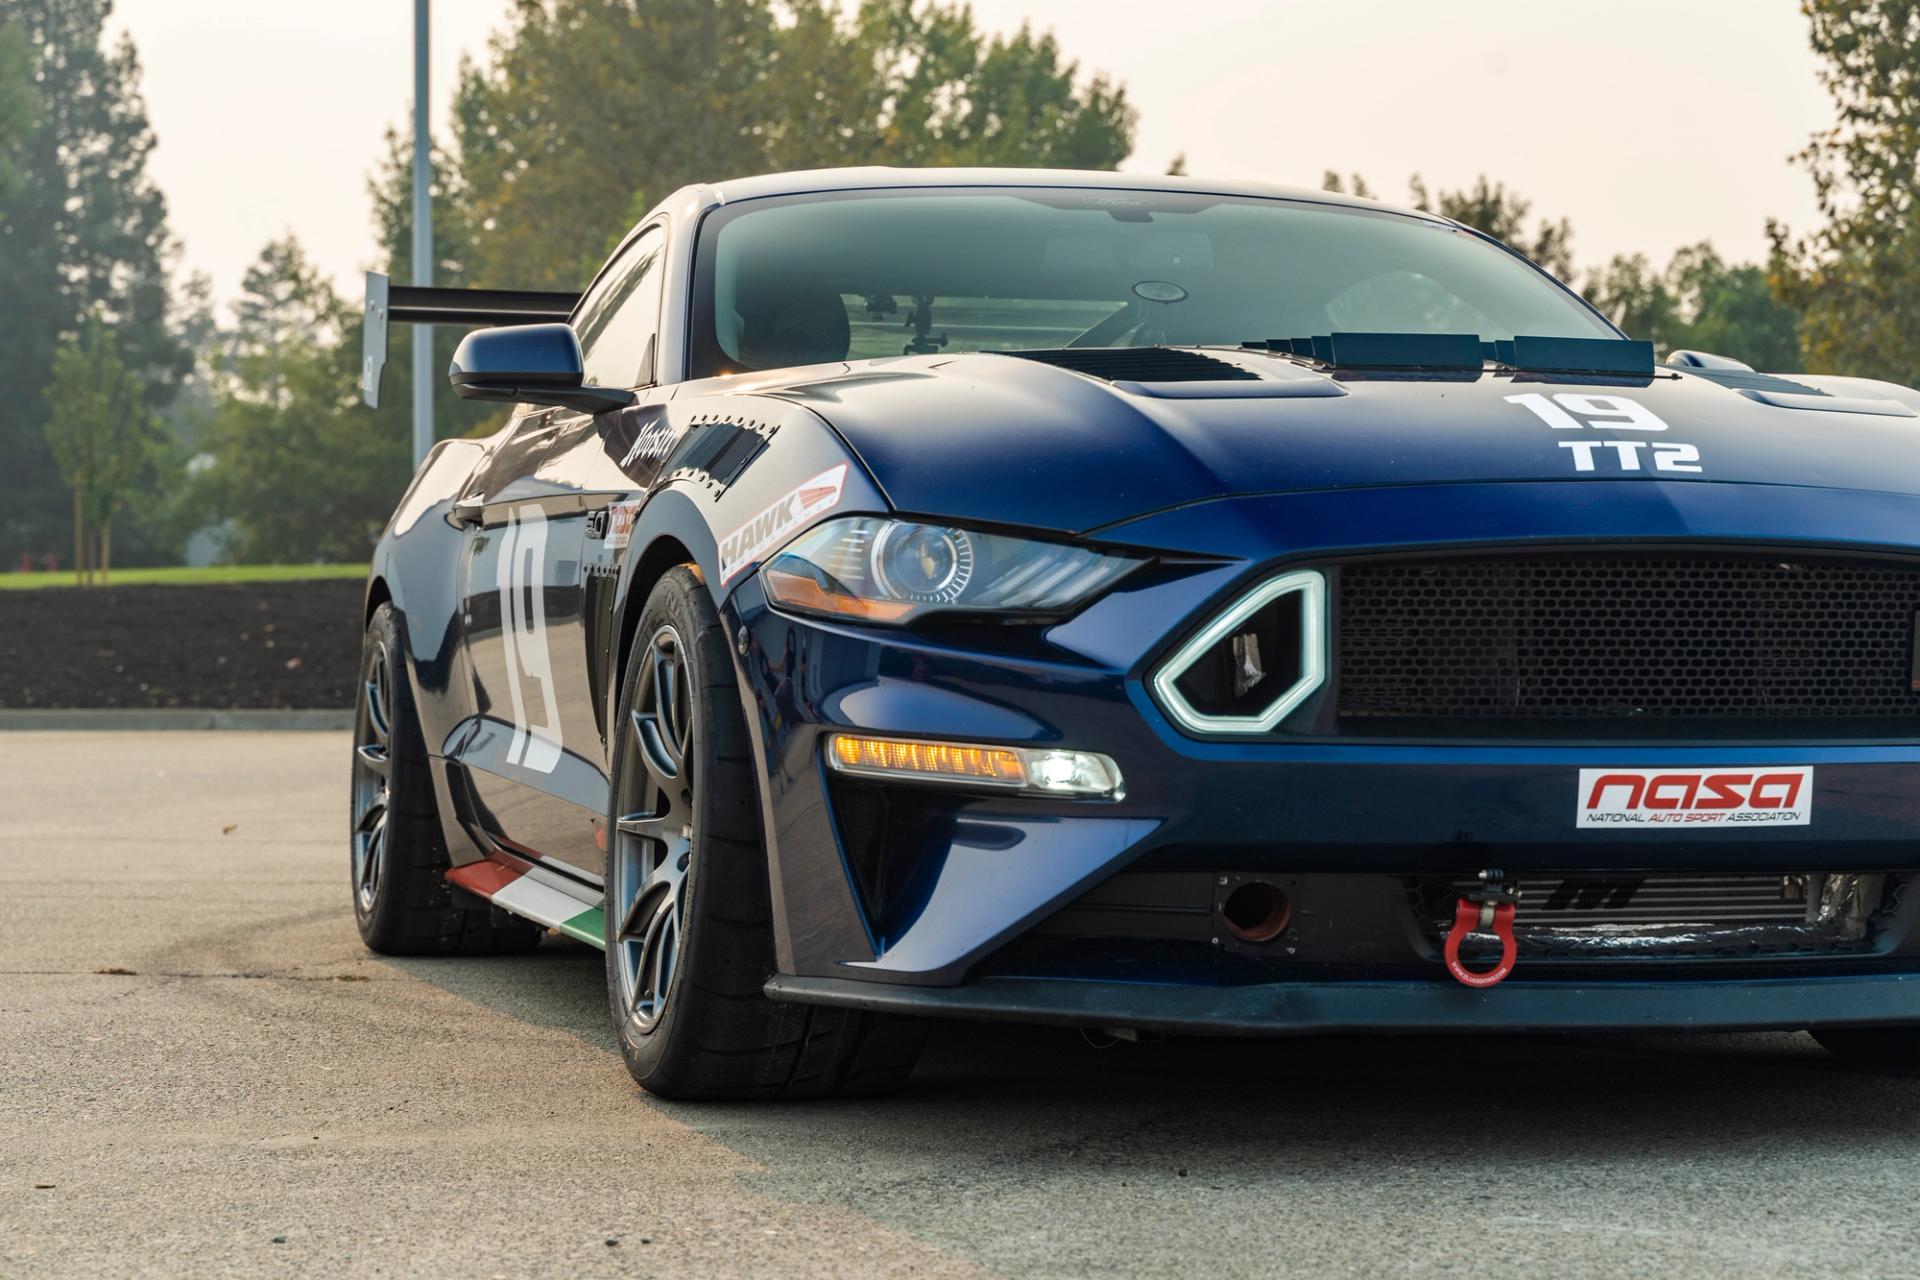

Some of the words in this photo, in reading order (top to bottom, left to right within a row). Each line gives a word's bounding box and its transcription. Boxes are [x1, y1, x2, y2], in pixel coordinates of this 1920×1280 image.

[1502, 393, 1669, 431] 19
[1558, 441, 1703, 472] TT2
[721, 493, 797, 571] HAWK
[496, 503, 563, 774] 19
[1586, 813, 1645, 823] NATIONAL
[1648, 813, 1683, 822] AUTO
[1684, 812, 1725, 822] SPORT
[1726, 811, 1802, 822] ASSOCIATION
